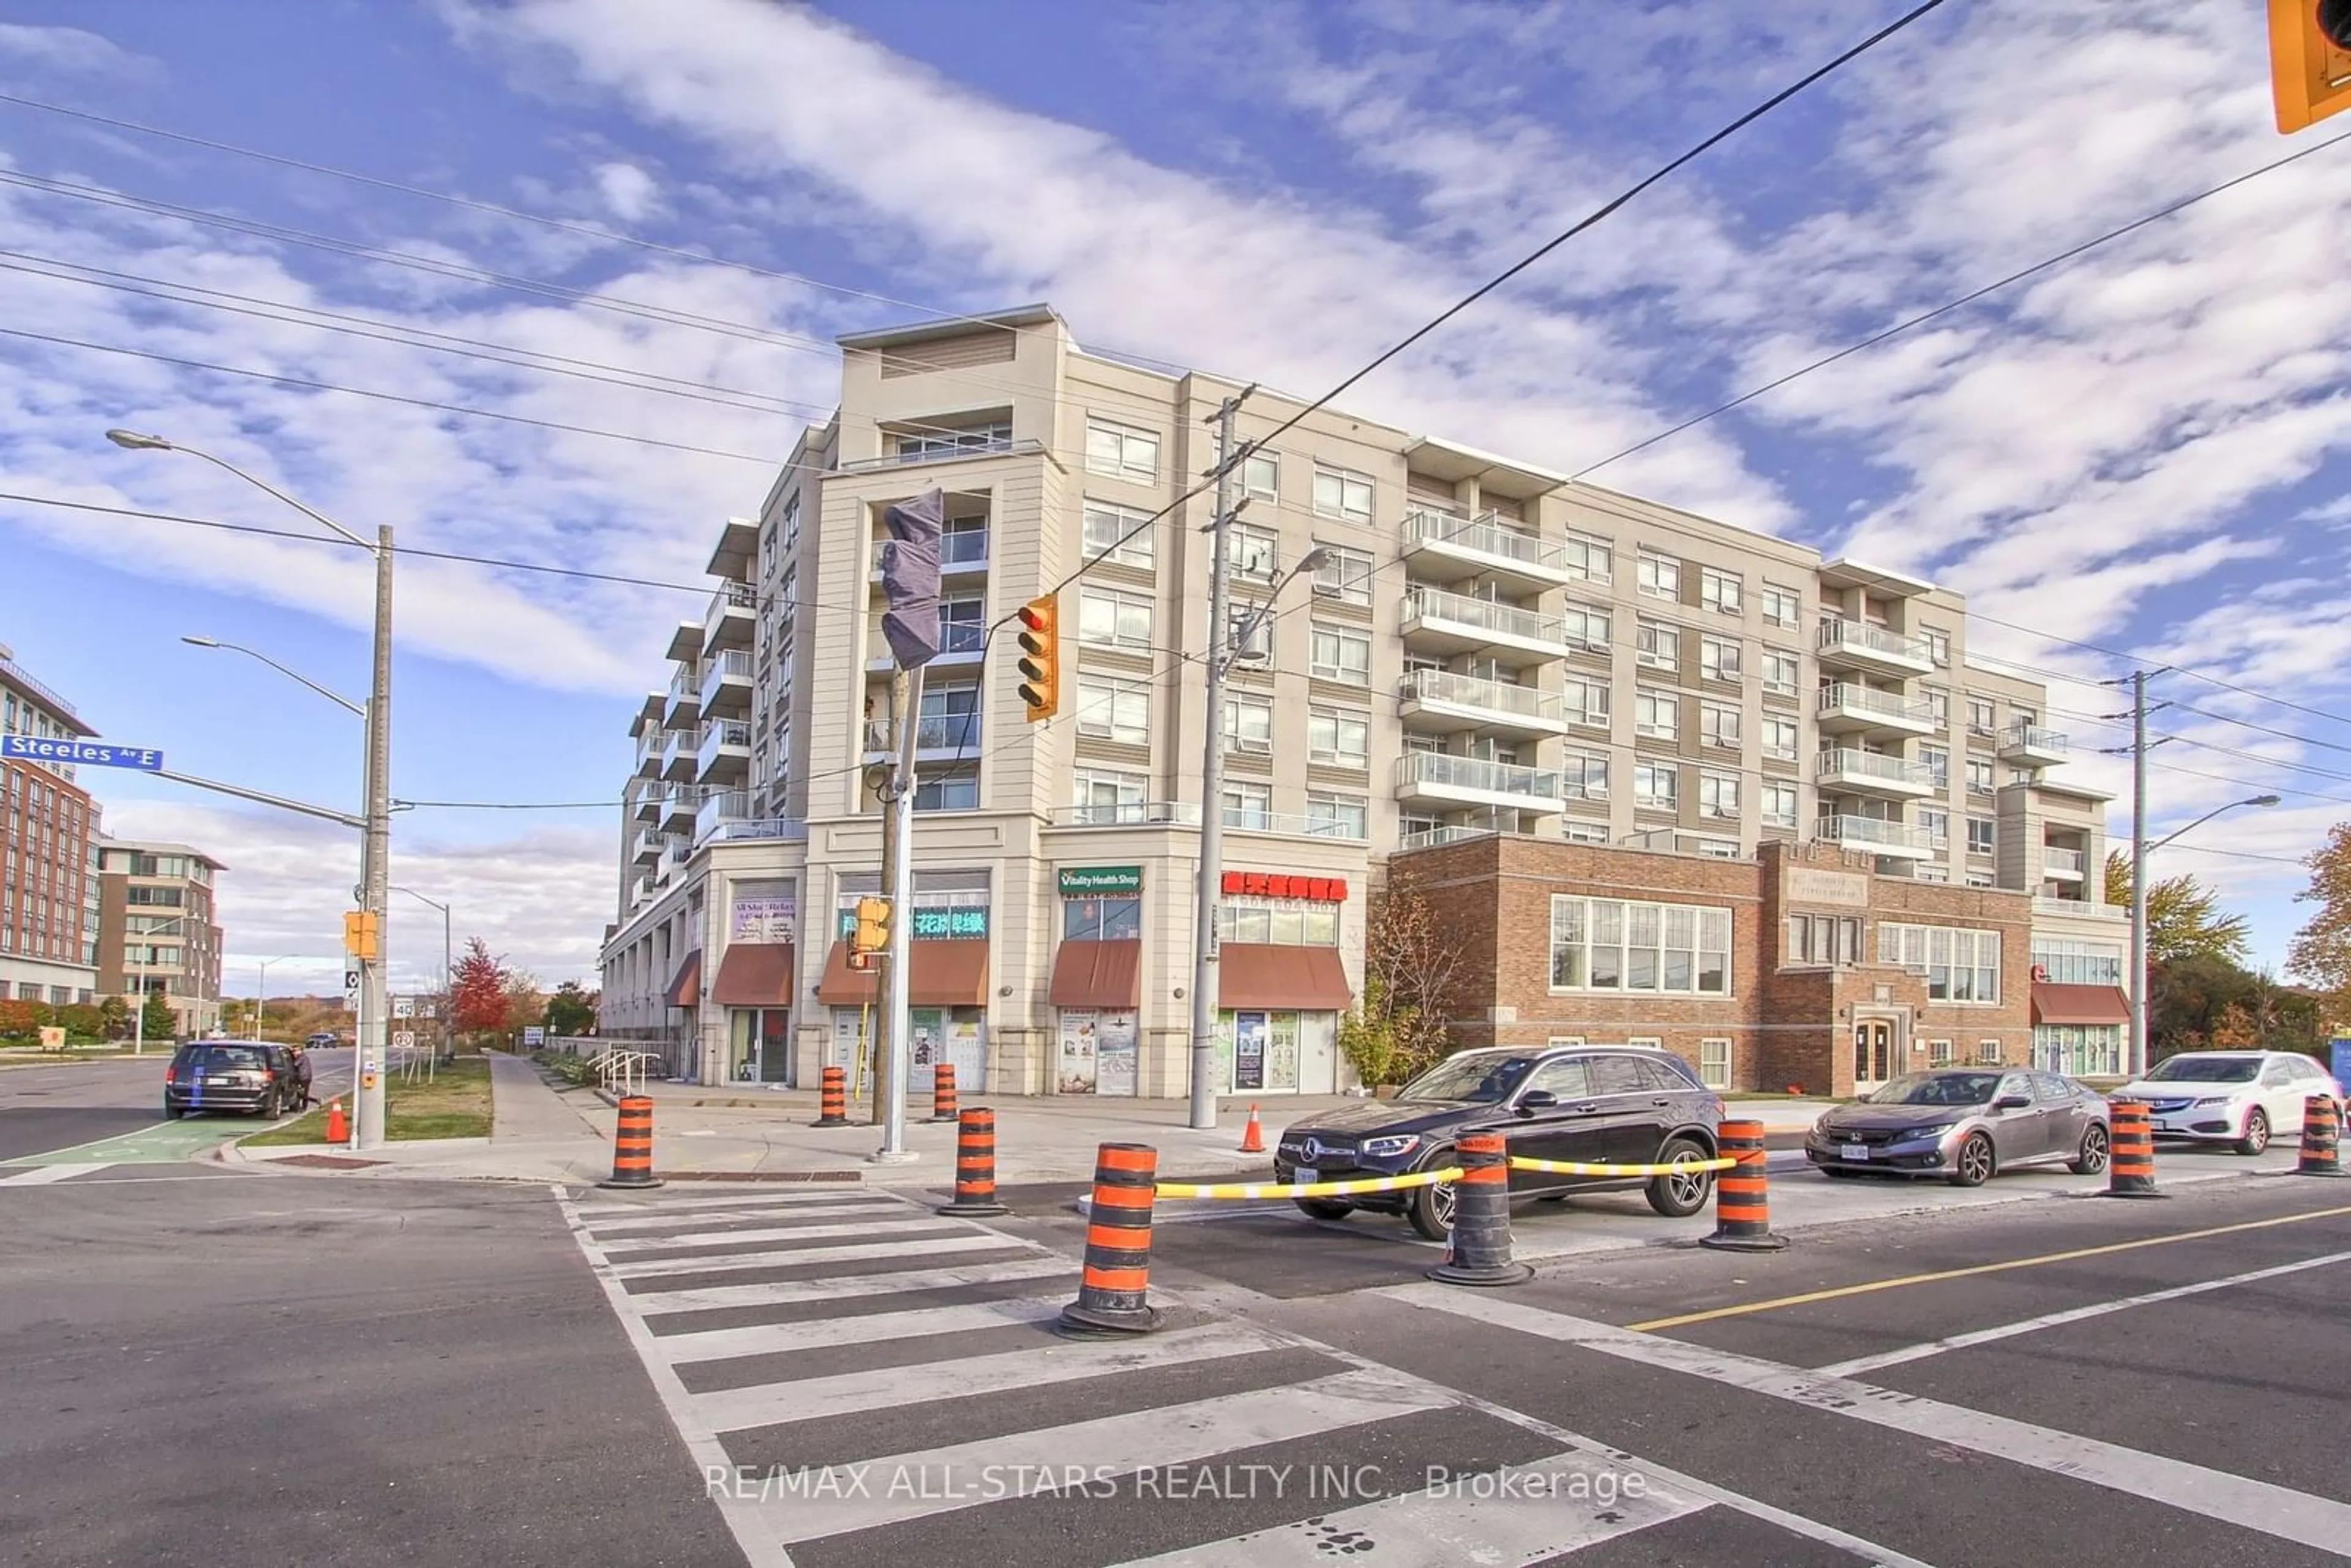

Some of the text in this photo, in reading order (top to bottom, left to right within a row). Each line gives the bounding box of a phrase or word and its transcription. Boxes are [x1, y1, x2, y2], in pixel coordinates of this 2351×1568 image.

[12, 737, 154, 765] Steeles Av E
[1061, 874, 1139, 887] Vitality Health Shop
[397, 1005, 412, 1015] 40
